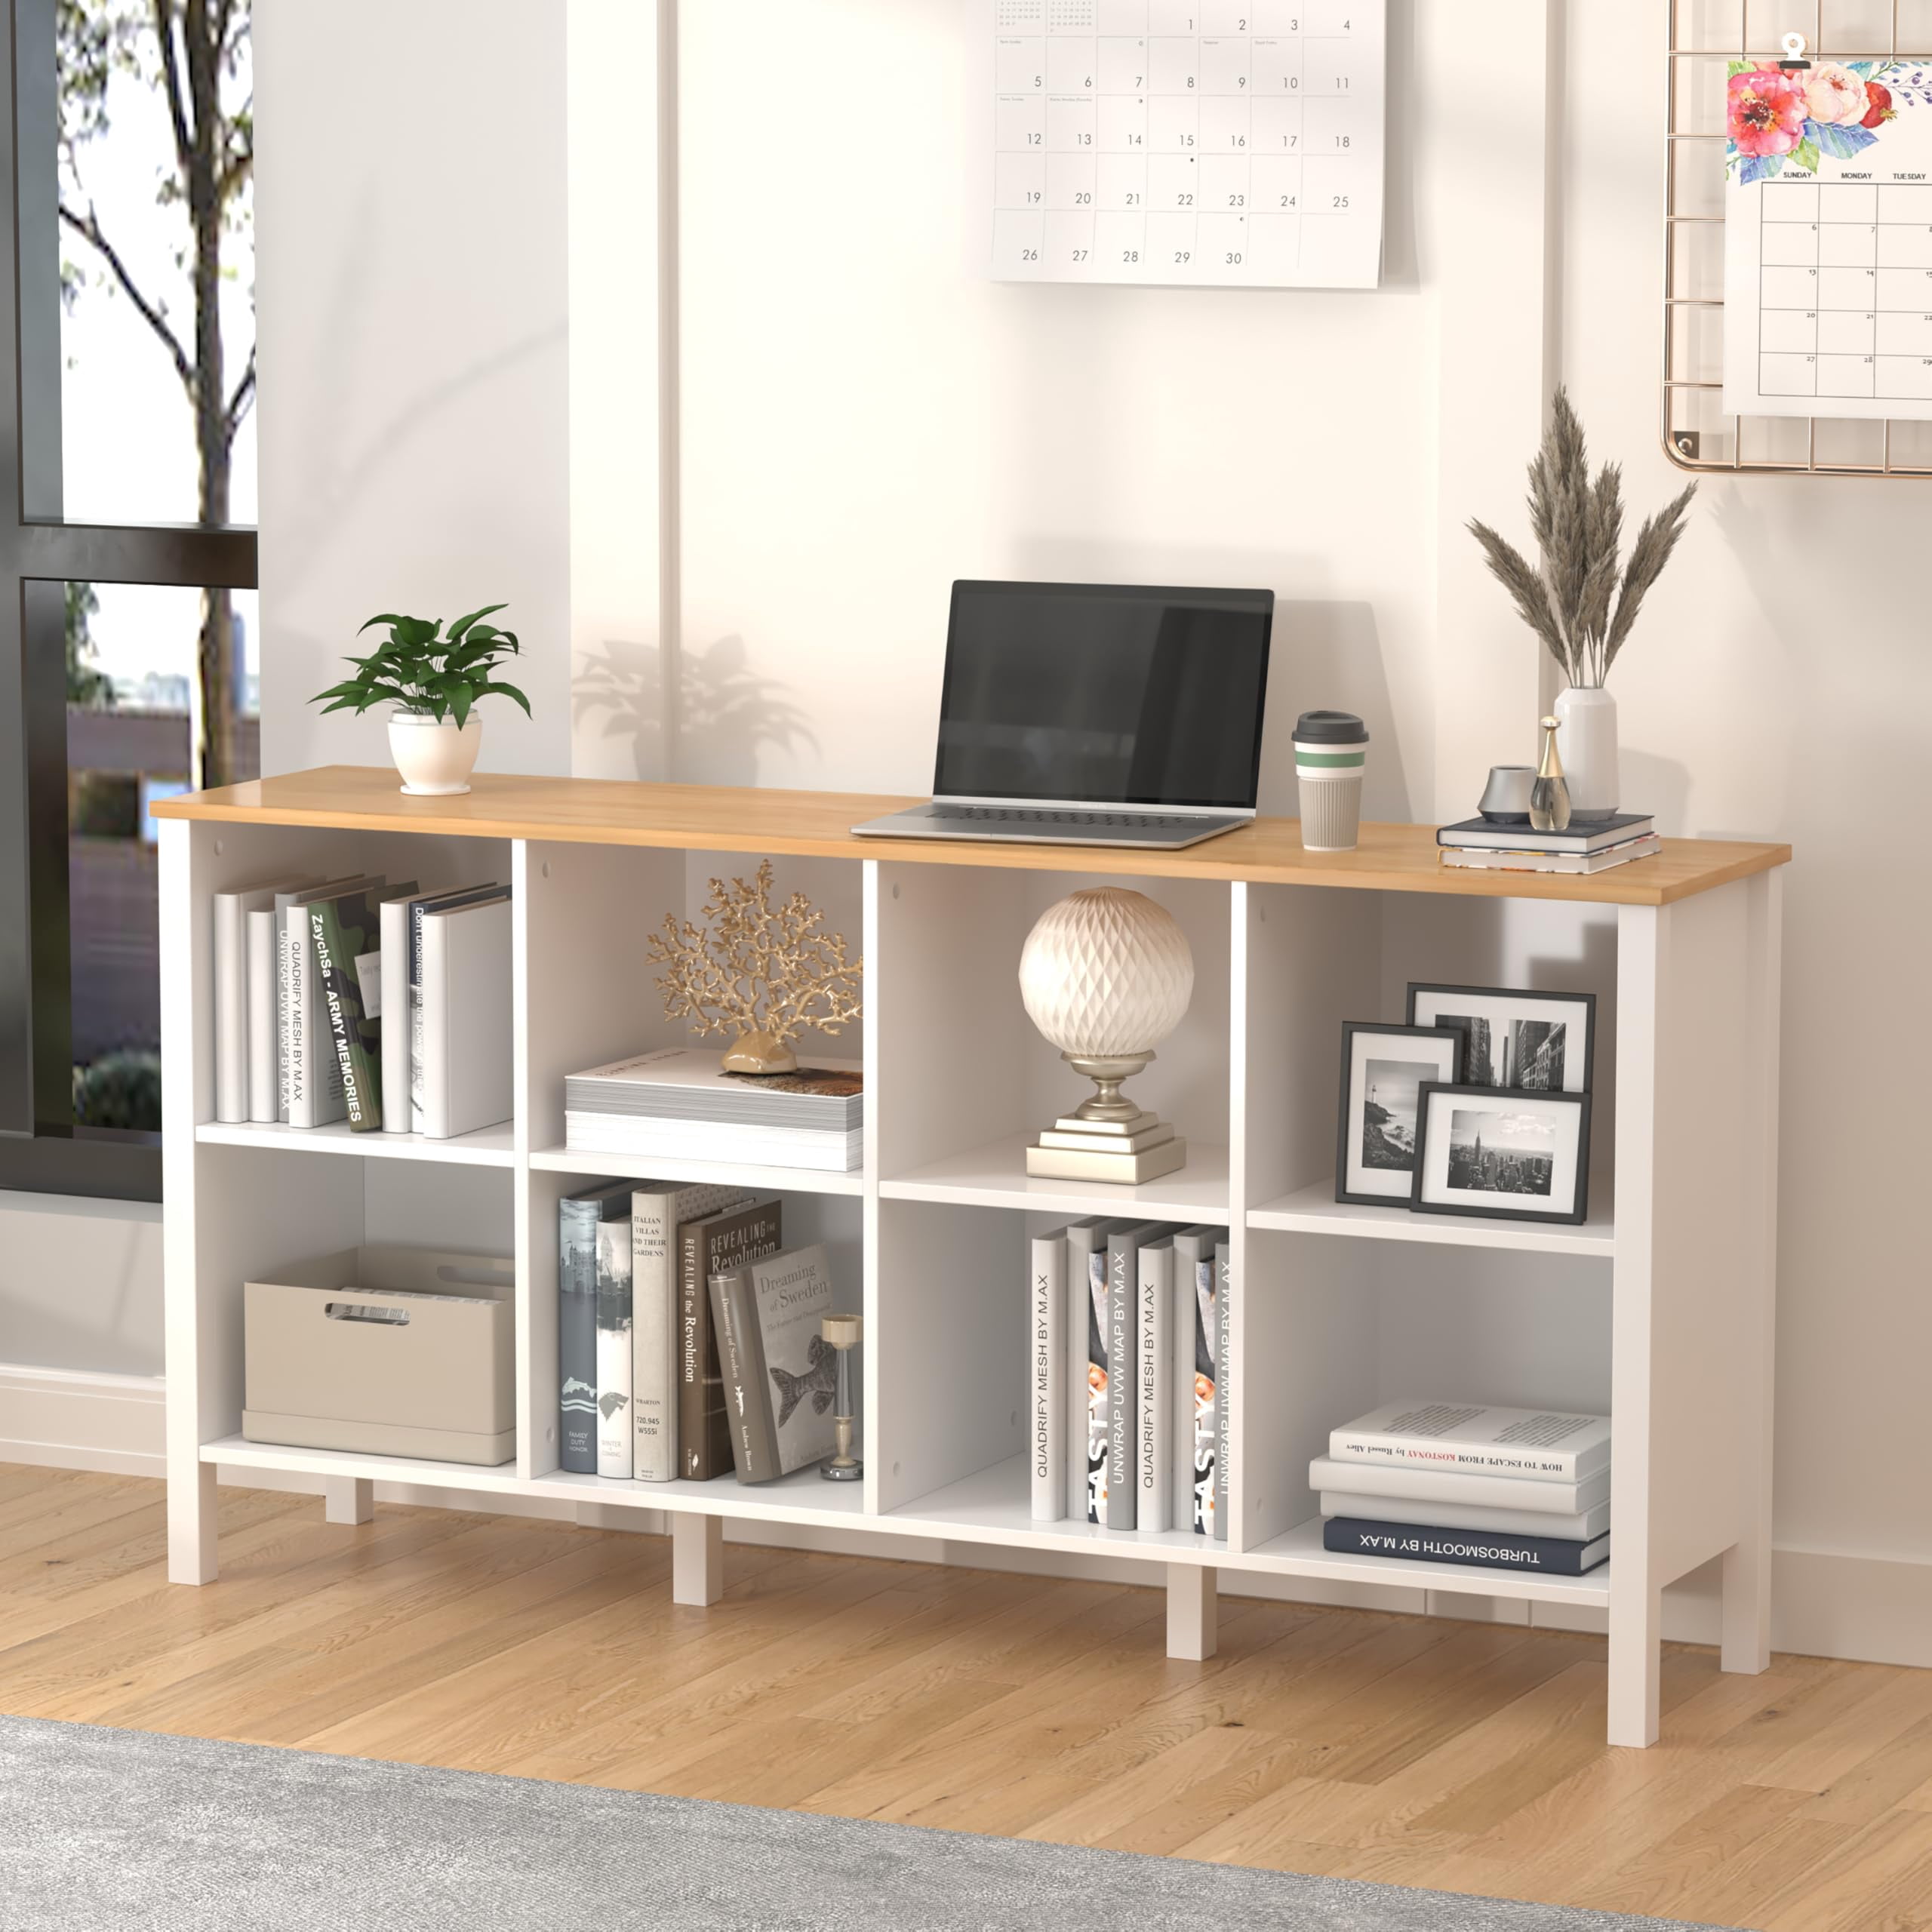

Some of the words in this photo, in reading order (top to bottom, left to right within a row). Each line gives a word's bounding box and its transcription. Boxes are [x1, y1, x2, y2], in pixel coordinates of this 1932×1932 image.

[1189, 19, 1192, 30] 1
[1238, 19, 1246, 31] 2
[1291, 19, 1298, 31] 3
[1343, 20, 1350, 30] 4
[1035, 75, 1041, 88] 5
[1084, 76, 1092, 88] 6
[1136, 76, 1143, 88] 7
[1187, 76, 1195, 88] 8
[1238, 77, 1246, 88] 9
[1284, 77, 1298, 89] 10
[1336, 78, 1349, 89] 11
[1028, 133, 1041, 145] 12
[1078, 134, 1092, 146] 13
[1128, 134, 1142, 146] 14
[1180, 134, 1194, 146] 15
[1231, 135, 1245, 147] 16
[1283, 135, 1297, 147] 17
[1336, 136, 1350, 148] 18
[1027, 192, 1041, 203] 19
[1075, 192, 1091, 205] 20
[1126, 193, 1140, 205] 21
[1177, 194, 1193, 205] 22
[1229, 194, 1244, 207] 23
[1281, 195, 1296, 207] 24
[1333, 195, 1349, 208] 25
[1023, 249, 1038, 261] 26
[1072, 250, 1088, 261] 27
[1123, 251, 1139, 263] 28
[1174, 251, 1190, 263] 29
[1226, 252, 1241, 264] 30
[291, 942, 302, 1007] QUADRIFY
[292, 1010, 302, 1047] MESH
[311, 914, 332, 979] ZaychSa
[326, 990, 346, 1035] ARMY
[336, 1038, 362, 1123] MEMORIES
[293, 1051, 302, 1067] BY
[293, 1069, 302, 1101] M.AX
[633, 1215, 661, 1224] ITALIAN
[635, 1226, 660, 1235] VILLAS
[711, 1220, 766, 1255] REVEALING
[685, 1238, 695, 1297] REVEALING
[712, 1239, 776, 1274] Revolution
[759, 1264, 817, 1294] Dreaming
[1113, 1252, 1124, 1294] M.AX
[770, 1299, 780, 1312] of
[779, 1279, 828, 1308] Sweden
[1038, 1275, 1048, 1315] M.AX
[1143, 1284, 1154, 1324] M.AX
[685, 1300, 693, 1313] the
[721, 1298, 732, 1337] Dreaming
[1113, 1298, 1124, 1321] BY
[1038, 1319, 1048, 1340] BY
[1143, 1328, 1154, 1349] BY
[685, 1317, 697, 1383] Revolution
[728, 1337, 736, 1346] of
[1113, 1324, 1124, 1361] MAP
[730, 1347, 740, 1378] Sweden
[1038, 1345, 1048, 1391] MESH
[1113, 1366, 1124, 1405] UVW
[1143, 1355, 1154, 1401] MESH
[636, 1416, 660, 1425] 720.945
[638, 1426, 658, 1435] W555i
[568, 1431, 589, 1439] FAMILY
[1038, 1392, 1048, 1478] QUADRIFY
[1143, 1401, 1154, 1488] QUADRIFY
[1113, 1410, 1124, 1484] UNWRAP
[1367, 1445, 1392, 1456] Russel
[1395, 1445, 1405, 1457] by
[1407, 1449, 1456, 1462] KOSTONAY
[1458, 1454, 1484, 1465] FROM
[1487, 1457, 1521, 1468] ESCAPE
[1524, 1461, 1538, 1470] TO
[1541, 1463, 1563, 1472] HOW
[1359, 1534, 1396, 1549] M.AX
[1400, 1539, 1420, 1552] BY
[1423, 1540, 1540, 1564] TURBOSMOOTH
